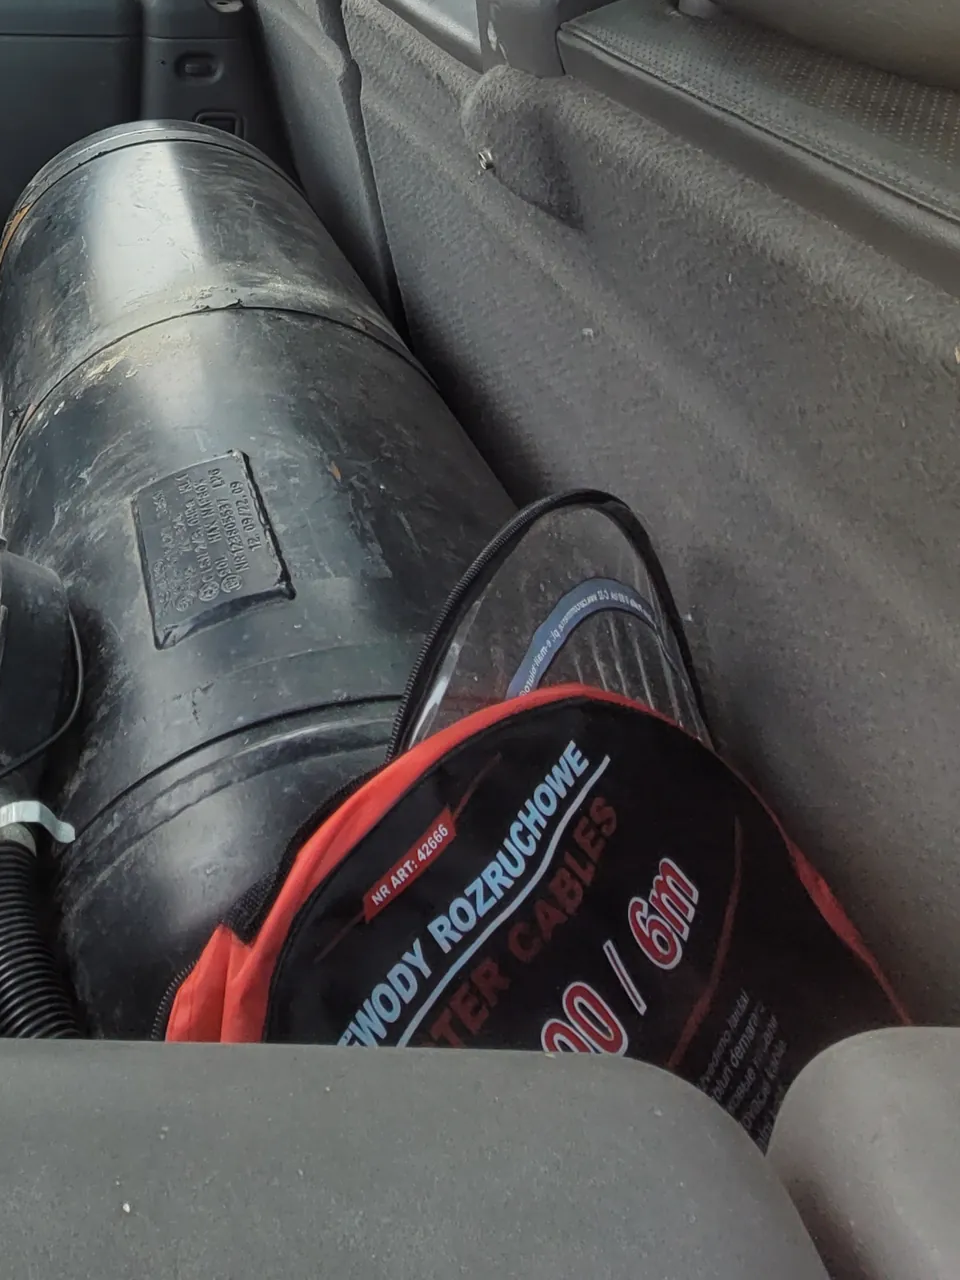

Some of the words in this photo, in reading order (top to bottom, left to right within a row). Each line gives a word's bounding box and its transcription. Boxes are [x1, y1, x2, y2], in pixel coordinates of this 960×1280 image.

[371, 886, 391, 907] NR
[390, 860, 420, 891] ART:
[415, 824, 450, 862] 42666
[427, 739, 590, 954] ROZRUCHOWE
[507, 796, 617, 963] CABLES
[628, 857, 700, 970] 6m
